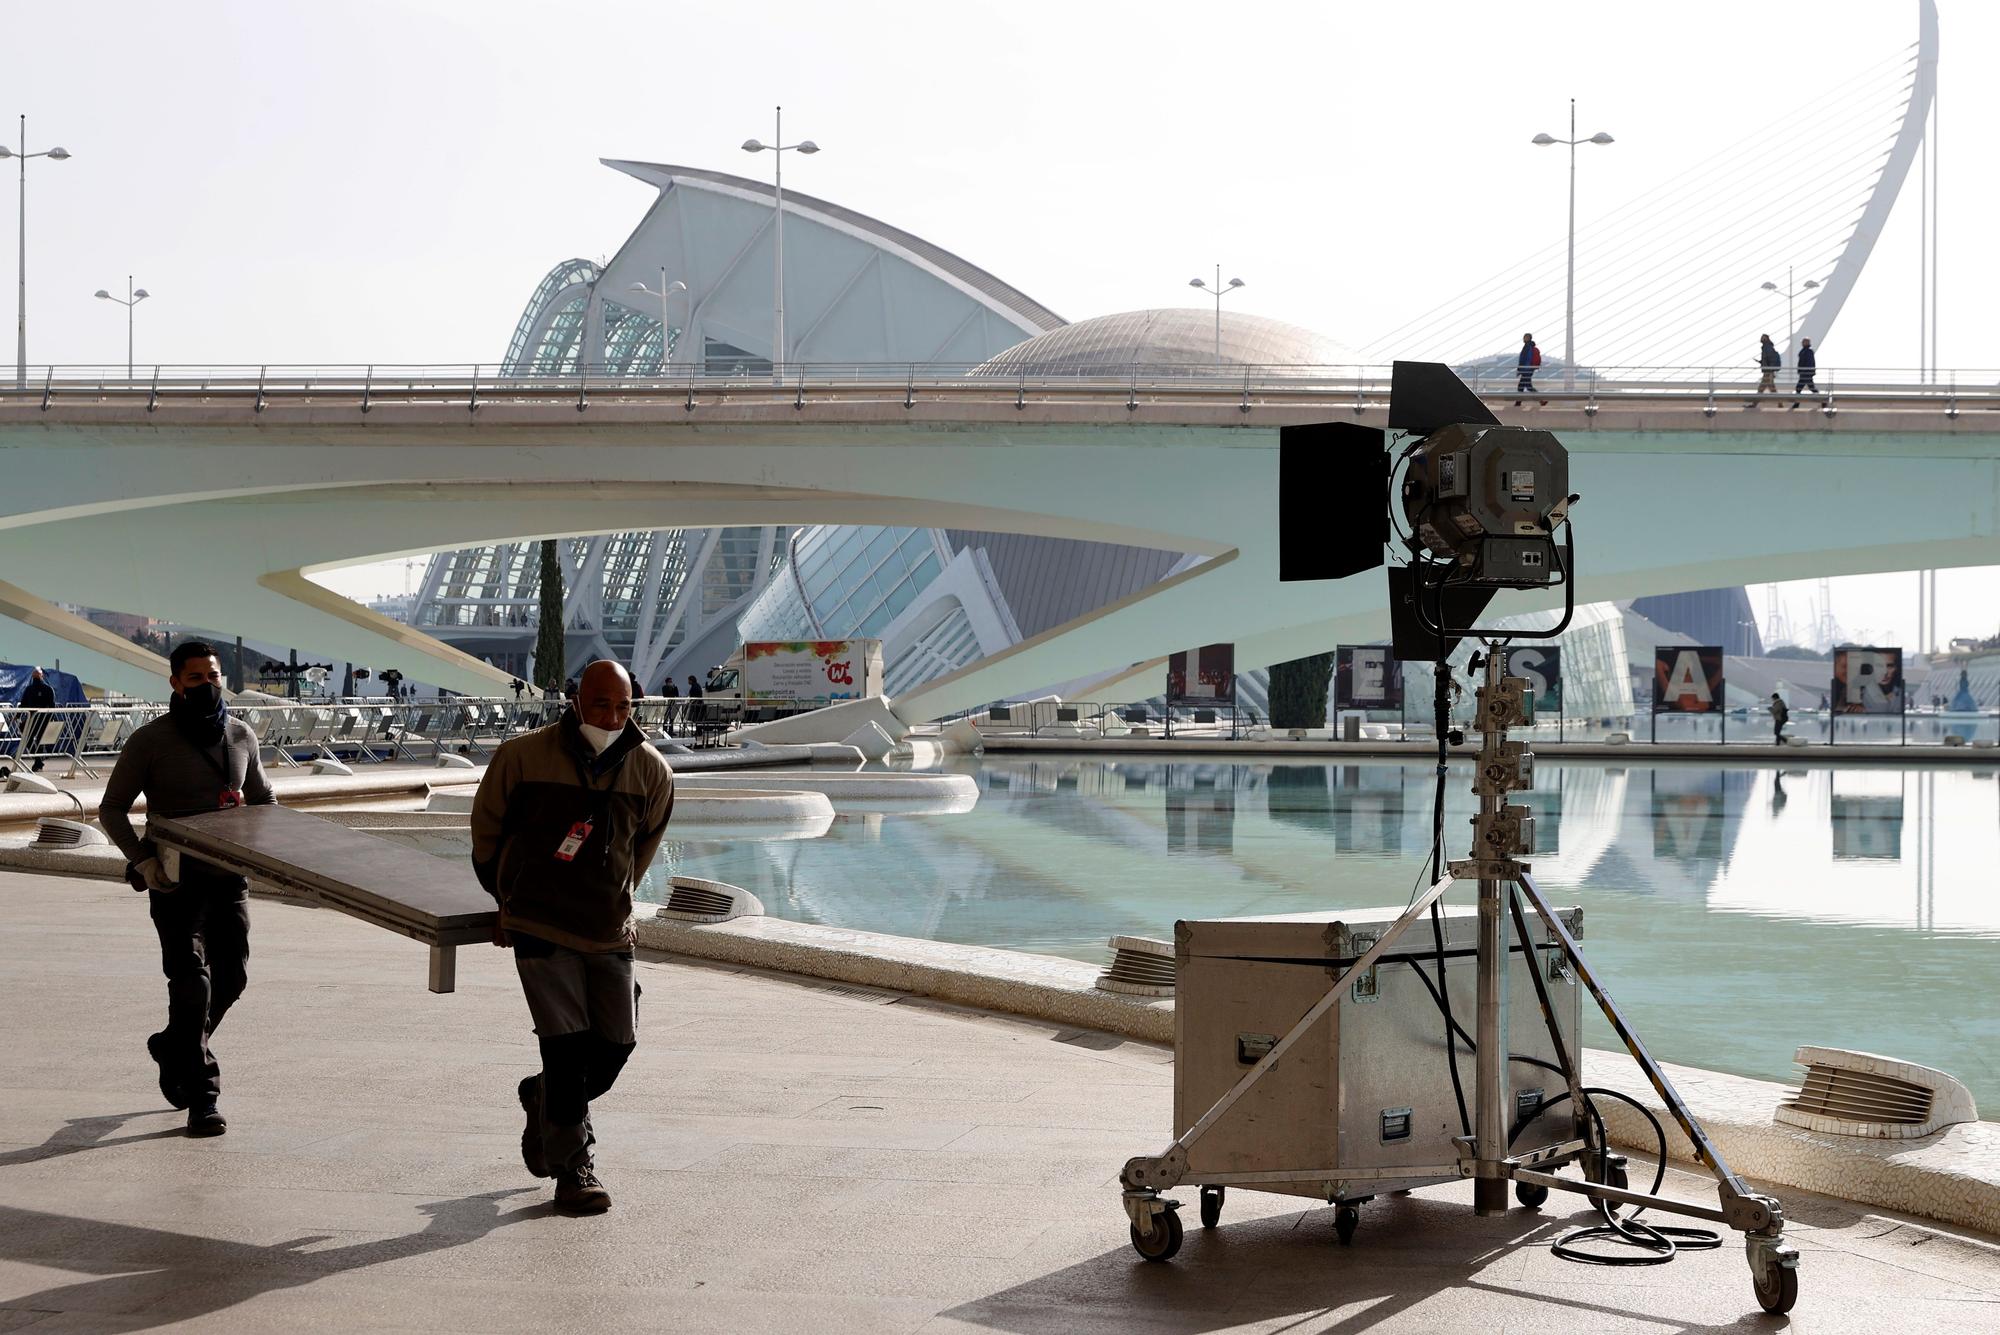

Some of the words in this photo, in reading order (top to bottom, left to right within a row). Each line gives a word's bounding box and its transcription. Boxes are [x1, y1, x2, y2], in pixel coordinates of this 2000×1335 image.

[831, 667, 845, 680] W
[1186, 648, 1216, 697] L
[1352, 649, 1385, 699] E
[1509, 648, 1547, 700] S
[1663, 650, 1713, 702] A
[1846, 651, 1889, 703] R
